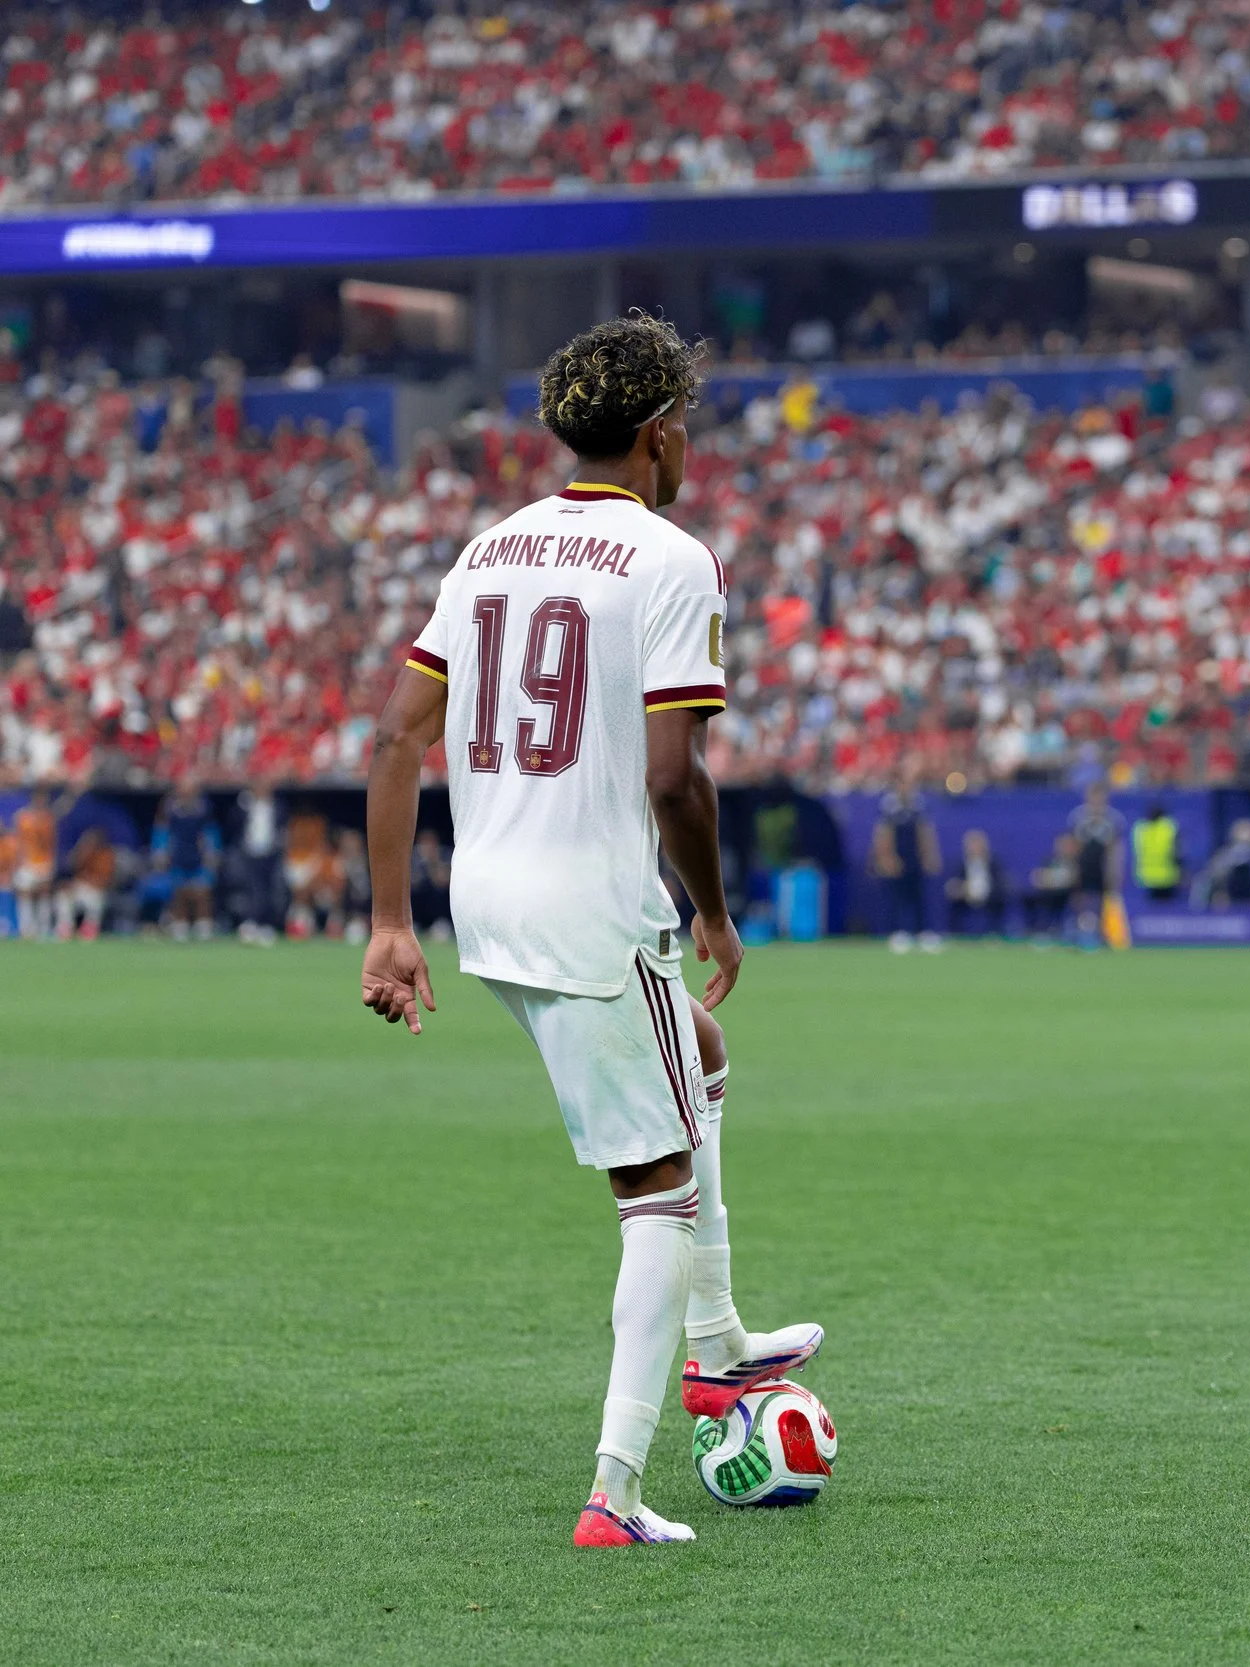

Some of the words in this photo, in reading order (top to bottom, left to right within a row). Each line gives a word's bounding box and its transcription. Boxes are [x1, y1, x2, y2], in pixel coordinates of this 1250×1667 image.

[467, 534, 555, 570] LAMINE
[554, 535, 637, 578] YAMAL
[467, 594, 590, 777] 19
